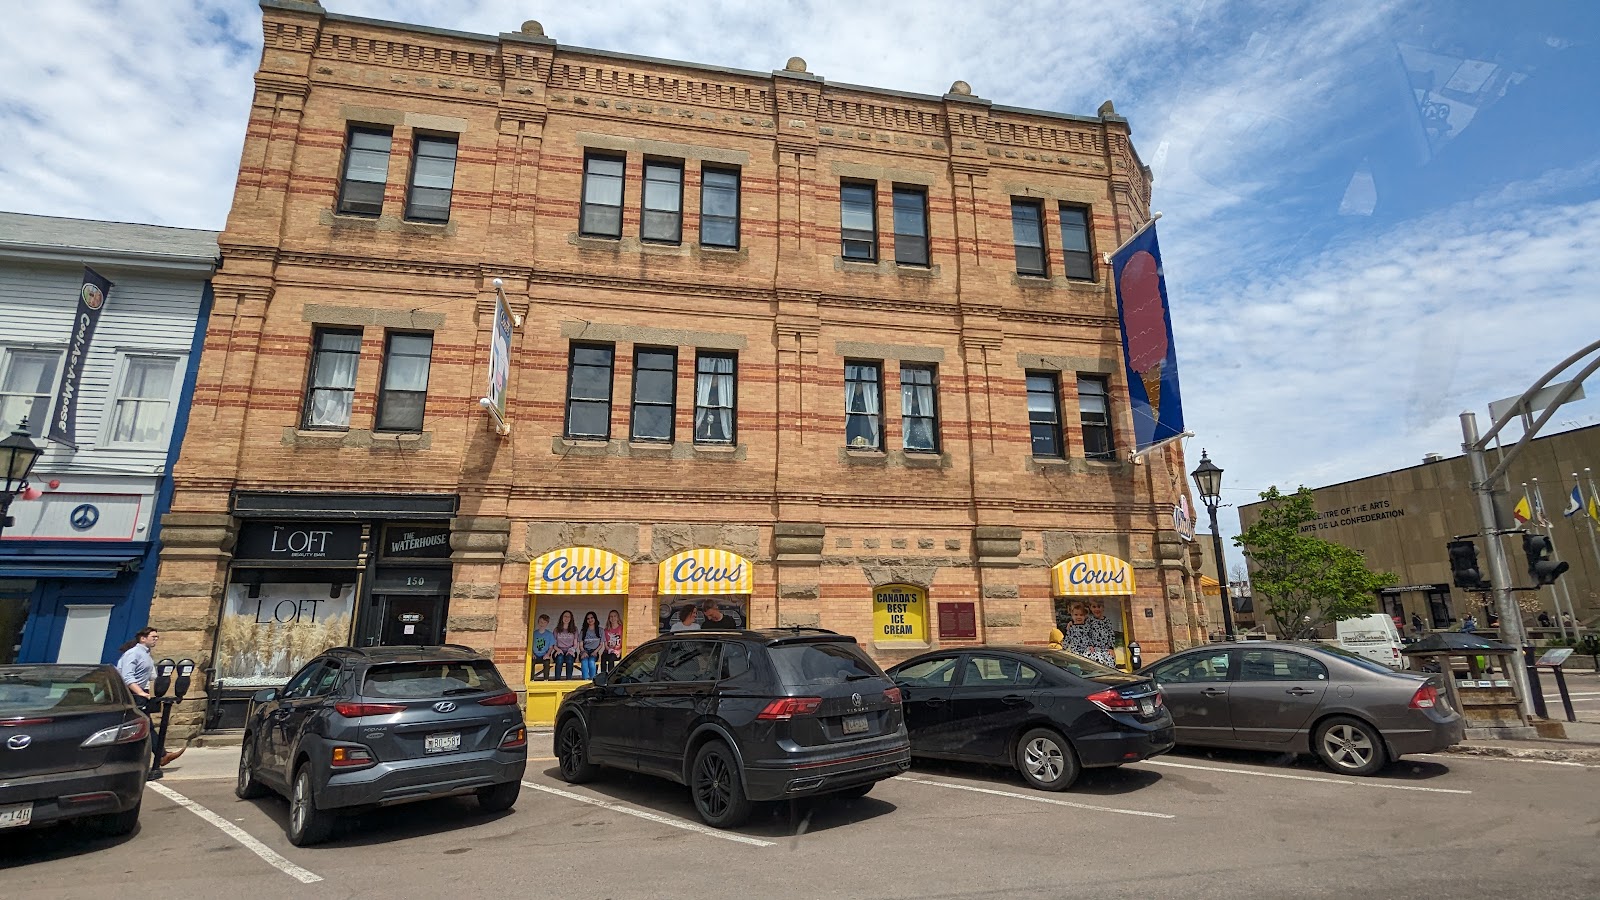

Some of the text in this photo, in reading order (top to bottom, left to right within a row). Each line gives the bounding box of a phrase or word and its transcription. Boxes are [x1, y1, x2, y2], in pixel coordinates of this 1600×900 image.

[1340, 507, 1351, 516] OF
[1352, 504, 1367, 514] THE
[1369, 500, 1390, 510] ARTS
[1300, 525, 1317, 534] ARTS
[1318, 522, 1329, 530] DE
[1330, 520, 1339, 529] LA
[1340, 508, 1405, 526] CONFEDERATION
[271, 530, 334, 552] LOFT
[391, 533, 447, 552] WATERHOUSE
[403, 531, 416, 541] THE
[542, 556, 617, 582] Cows
[673, 557, 742, 583] Cows
[1069, 561, 1125, 585] Cows
[406, 576, 425, 586] 150
[876, 593, 917, 603] CANADA'S
[255, 599, 325, 624] LOFT
[887, 603, 908, 613] BEST
[891, 614, 905, 624] ICE
[884, 624, 913, 635] CREAM
